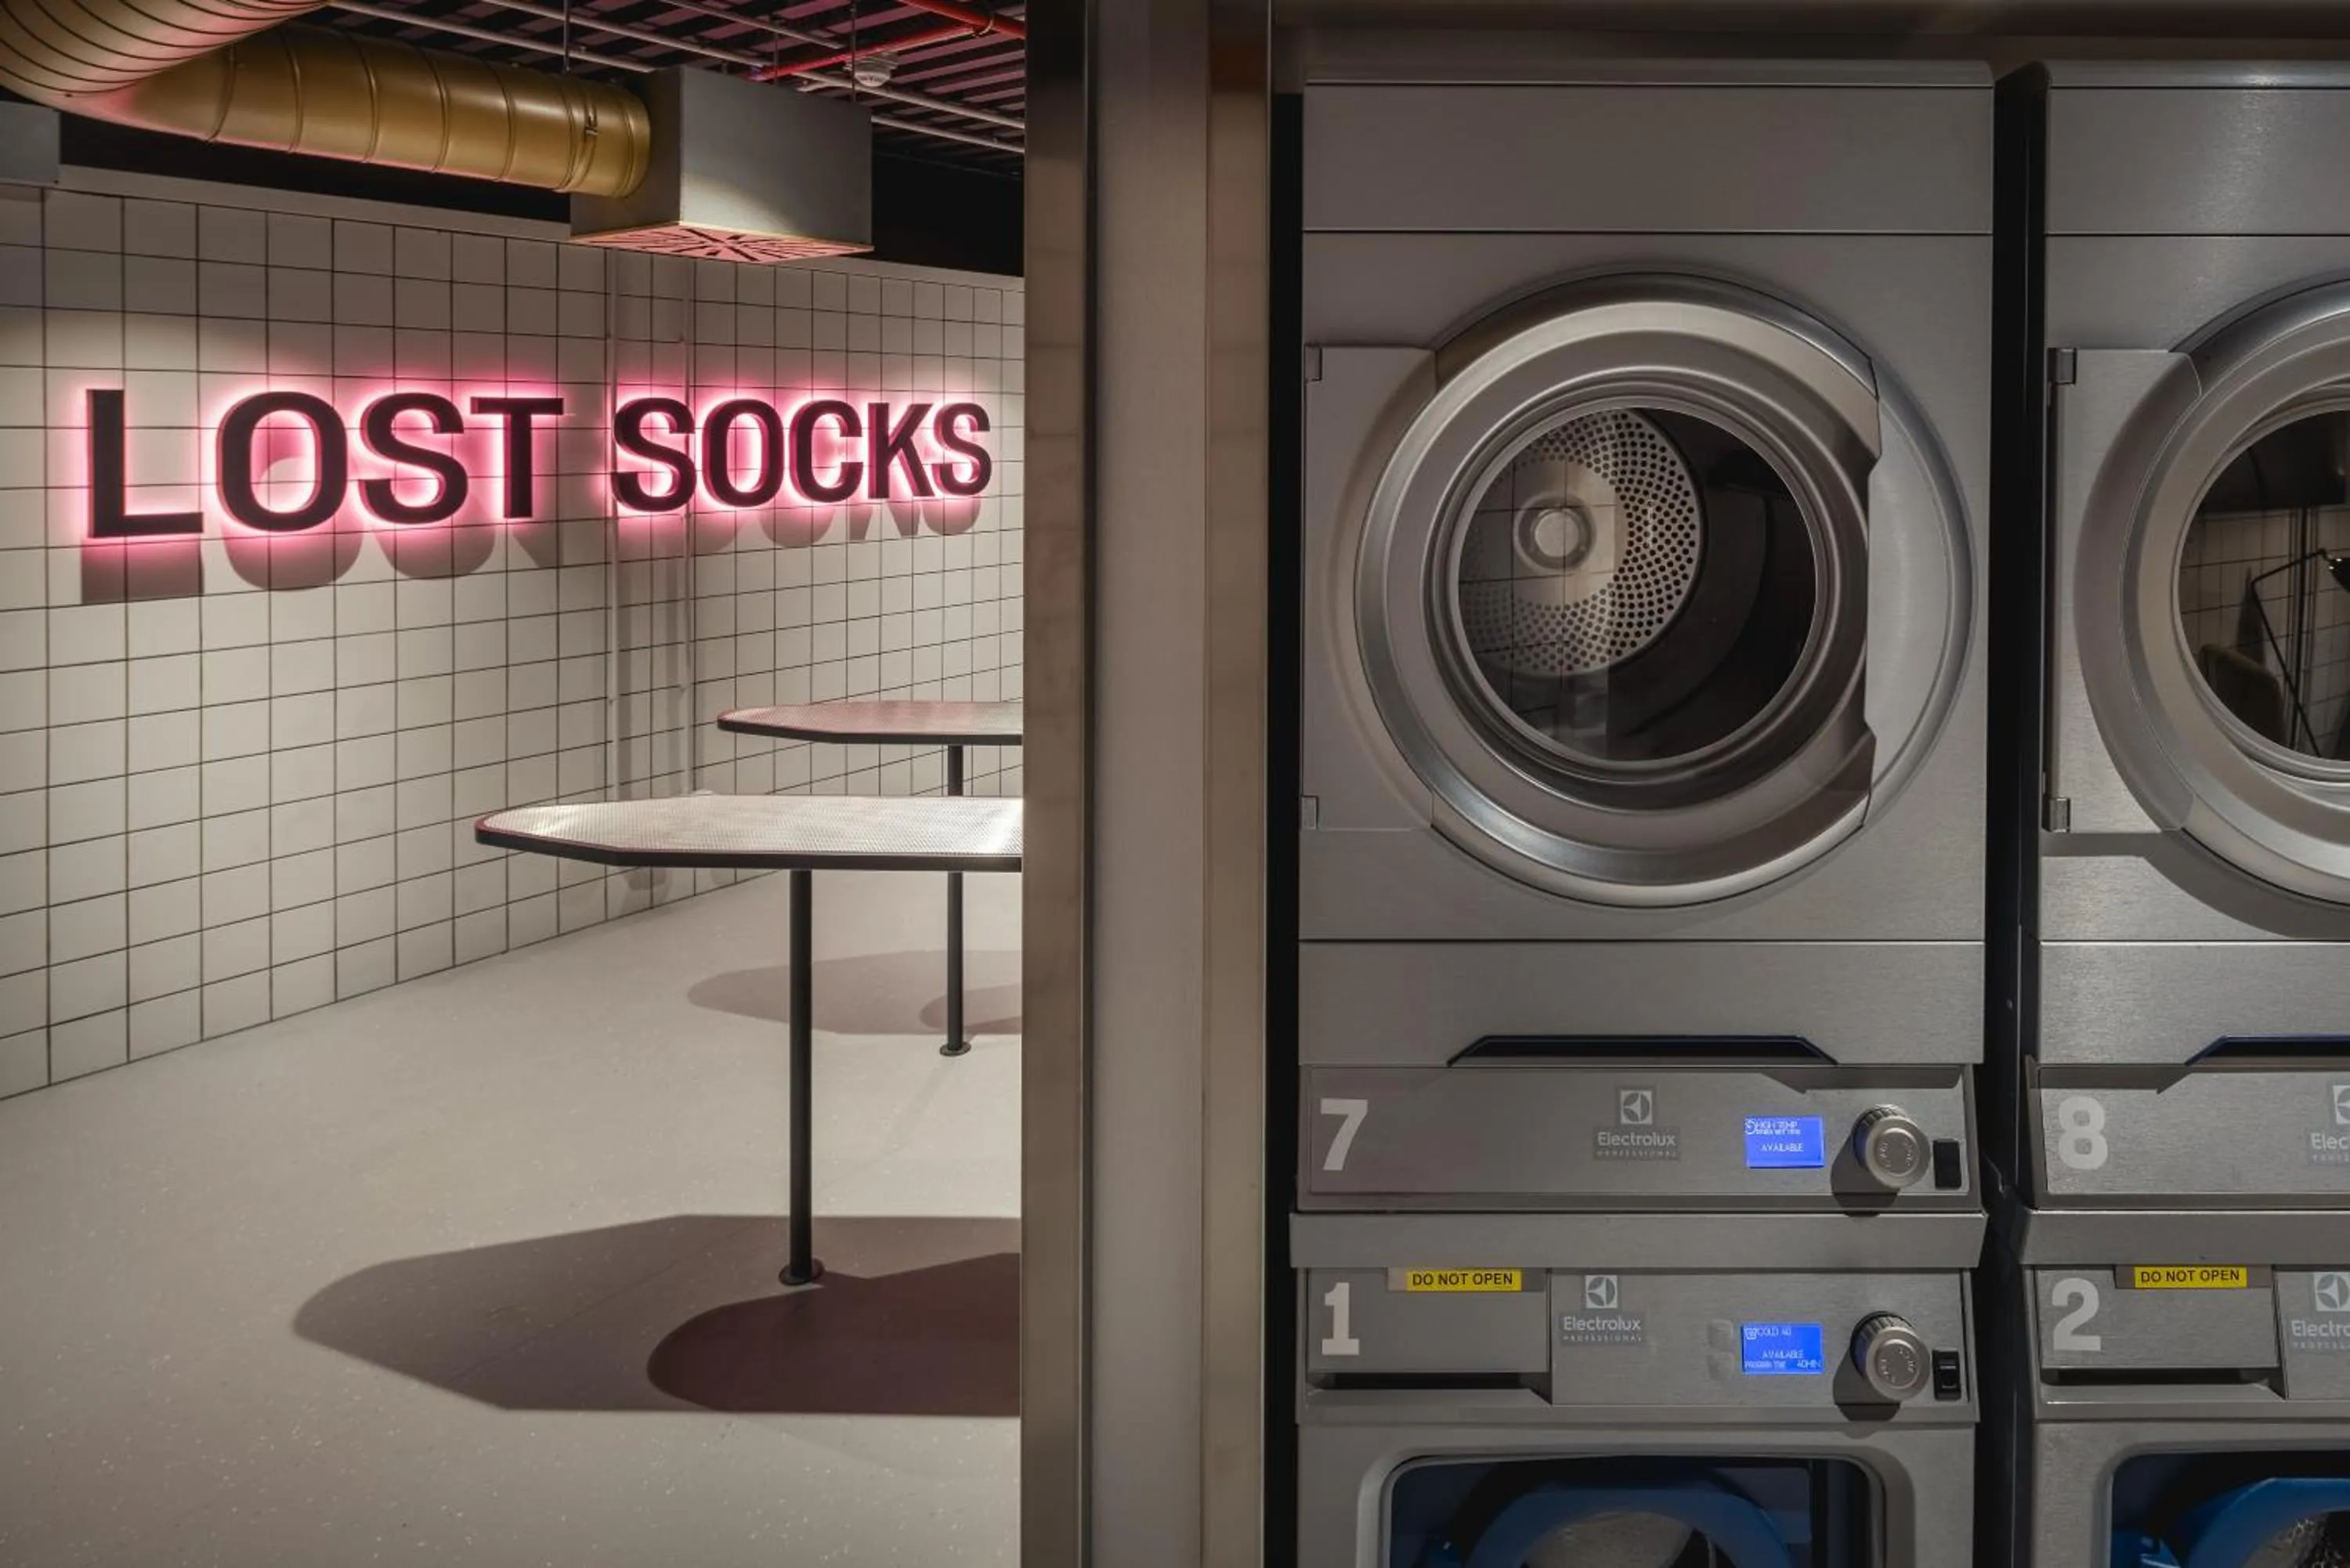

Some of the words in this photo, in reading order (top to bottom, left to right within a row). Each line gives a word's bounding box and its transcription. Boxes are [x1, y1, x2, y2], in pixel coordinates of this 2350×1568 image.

[85, 388, 564, 539] LOST
[610, 396, 992, 512] SOCKS
[1320, 1098, 1368, 1172] 7
[1597, 1131, 1676, 1147] Electrolux
[2058, 1096, 2109, 1170] 8
[1760, 1142, 1804, 1152] AVAILABLE
[1412, 1274, 1434, 1286] DO
[1438, 1274, 1469, 1286] NOT
[1472, 1273, 1513, 1285] OPEN
[2141, 1270, 2161, 1283] DO
[2166, 1270, 2196, 1282] NOT
[2200, 1268, 2240, 1281] OPEN
[1321, 1281, 1360, 1356] 1
[2052, 1277, 2102, 1351] 2
[1564, 1315, 1642, 1331] Electrolux
[1761, 1349, 1805, 1359] AVAILABLE
